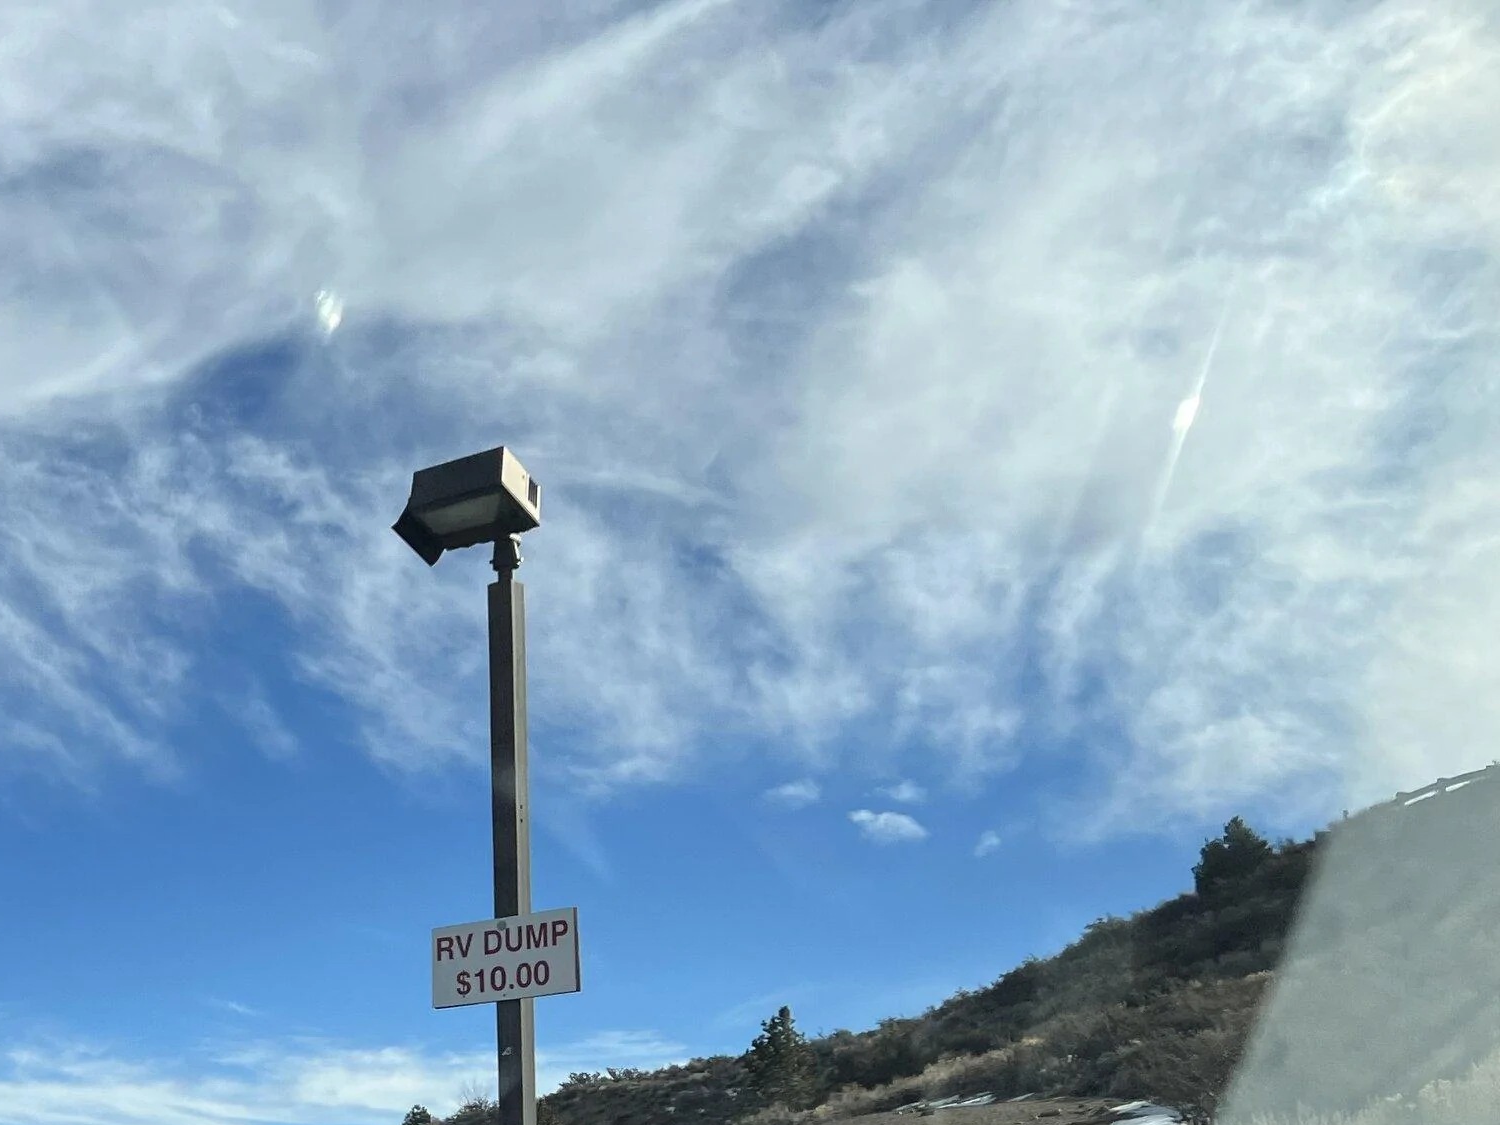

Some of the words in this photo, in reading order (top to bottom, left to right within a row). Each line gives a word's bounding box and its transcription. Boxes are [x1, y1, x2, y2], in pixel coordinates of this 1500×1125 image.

[436, 933, 473, 961] RV
[484, 919, 568, 955] DUMP
[456, 960, 550, 997] $10.00
